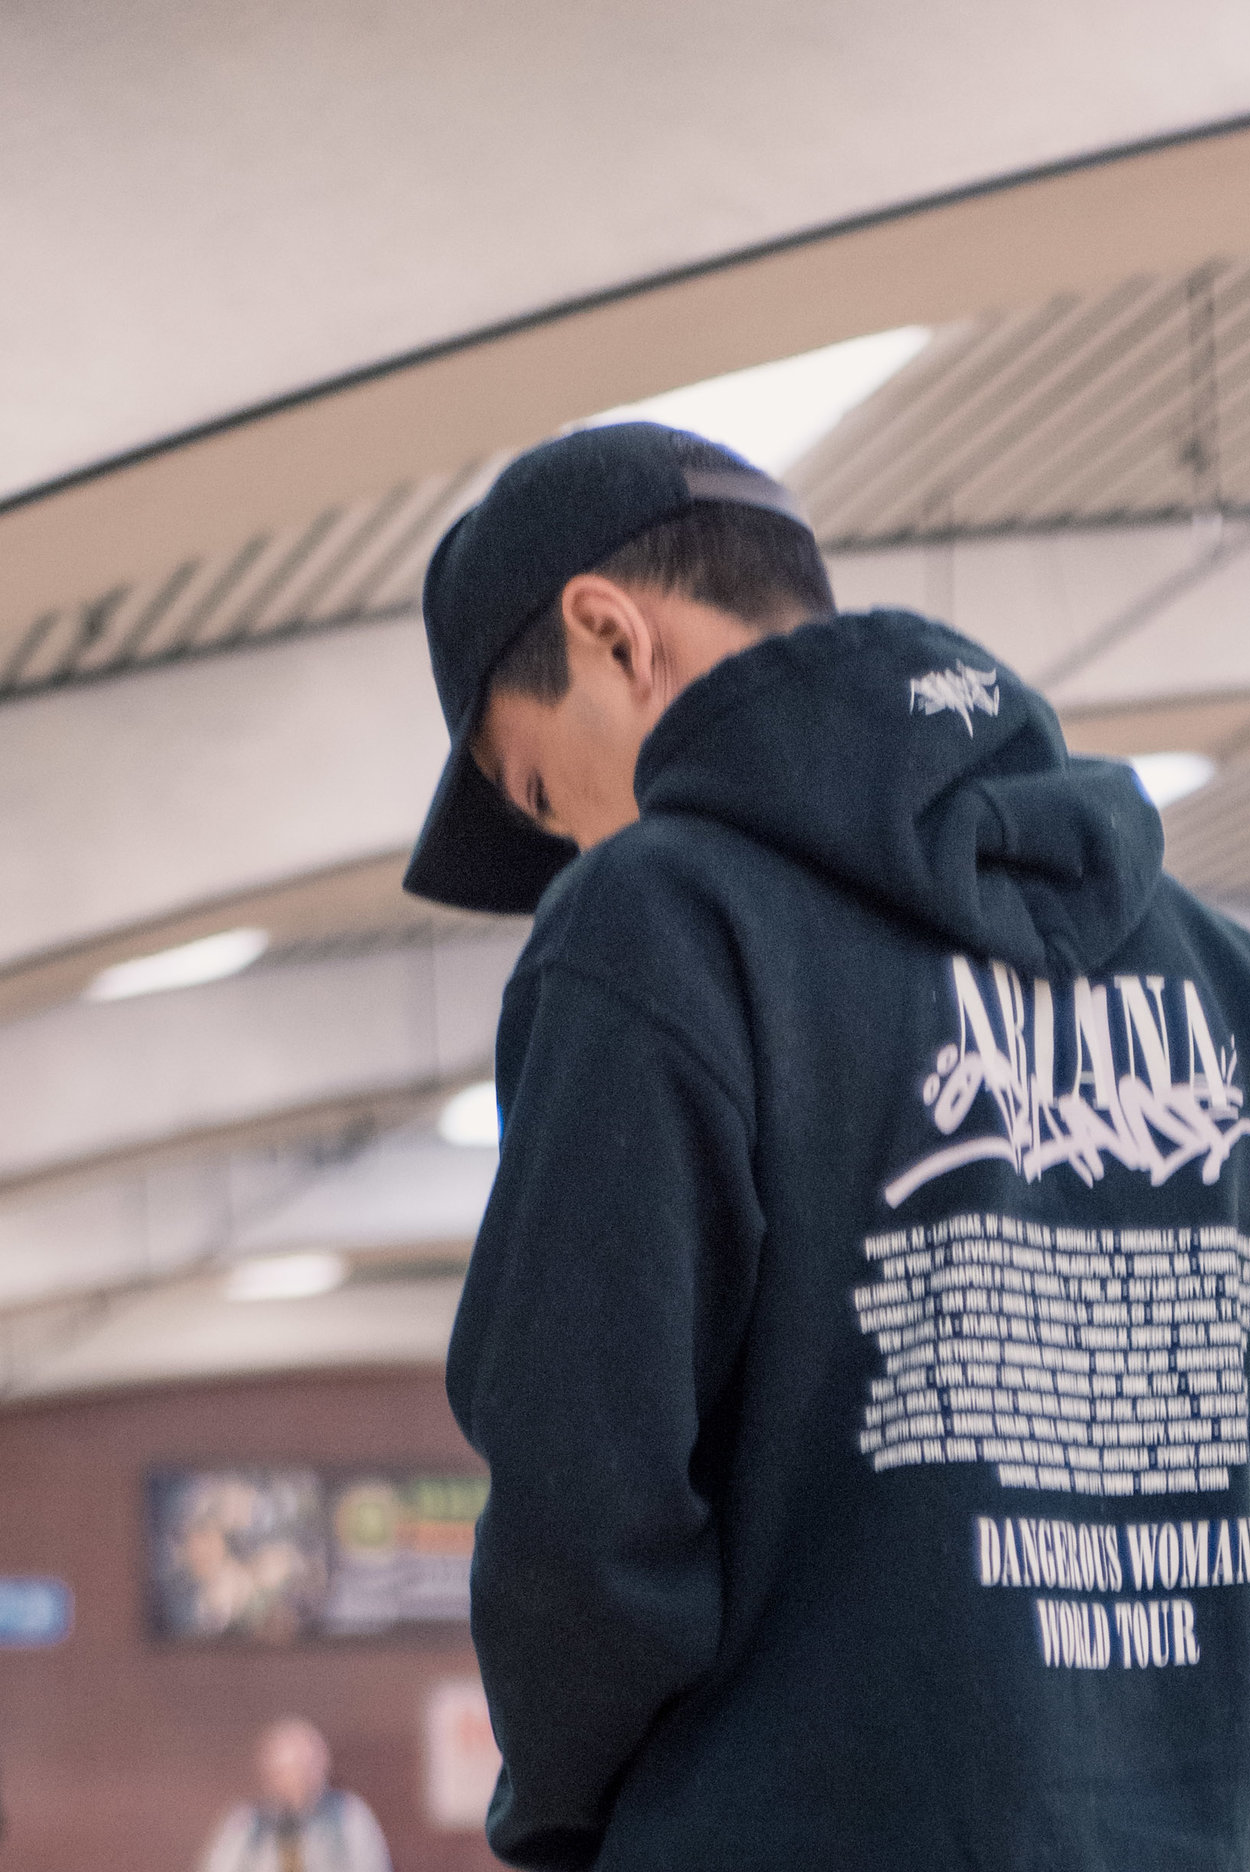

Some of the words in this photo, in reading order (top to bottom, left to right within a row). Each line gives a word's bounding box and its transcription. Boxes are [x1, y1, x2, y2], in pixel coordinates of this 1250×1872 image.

[950, 954, 1244, 1122] ARIANA
[977, 1516, 1122, 1592] DANGEROUS
[1037, 1598, 1111, 1670] WORLD
[1114, 1598, 1201, 1670] TOUR
